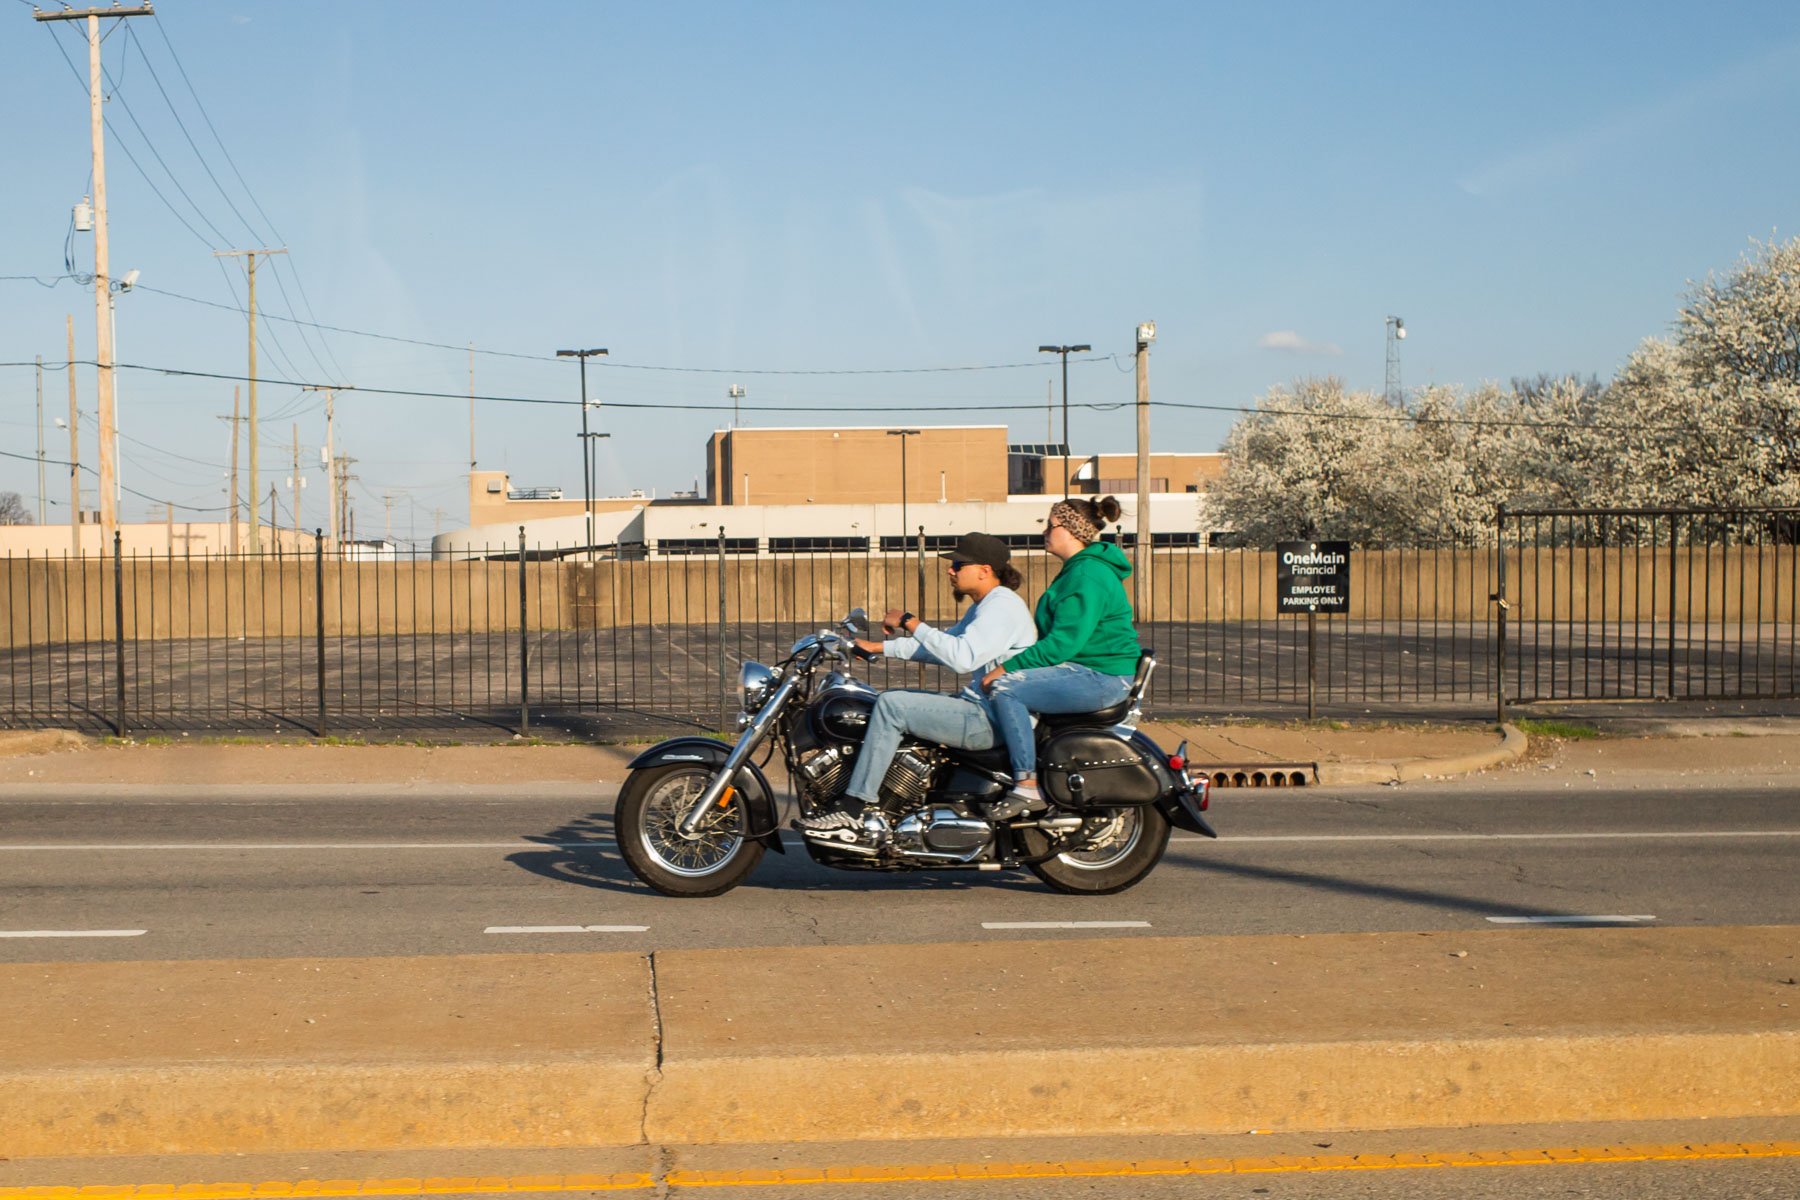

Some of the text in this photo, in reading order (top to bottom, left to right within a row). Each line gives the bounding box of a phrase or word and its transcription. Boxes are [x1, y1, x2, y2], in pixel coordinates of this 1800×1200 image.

[1283, 551, 1345, 565] OneMain
[1291, 565, 1337, 575] Financial
[1291, 585, 1336, 595] EMPLOYEE
[1283, 596, 1345, 606] PARKING ONLY
